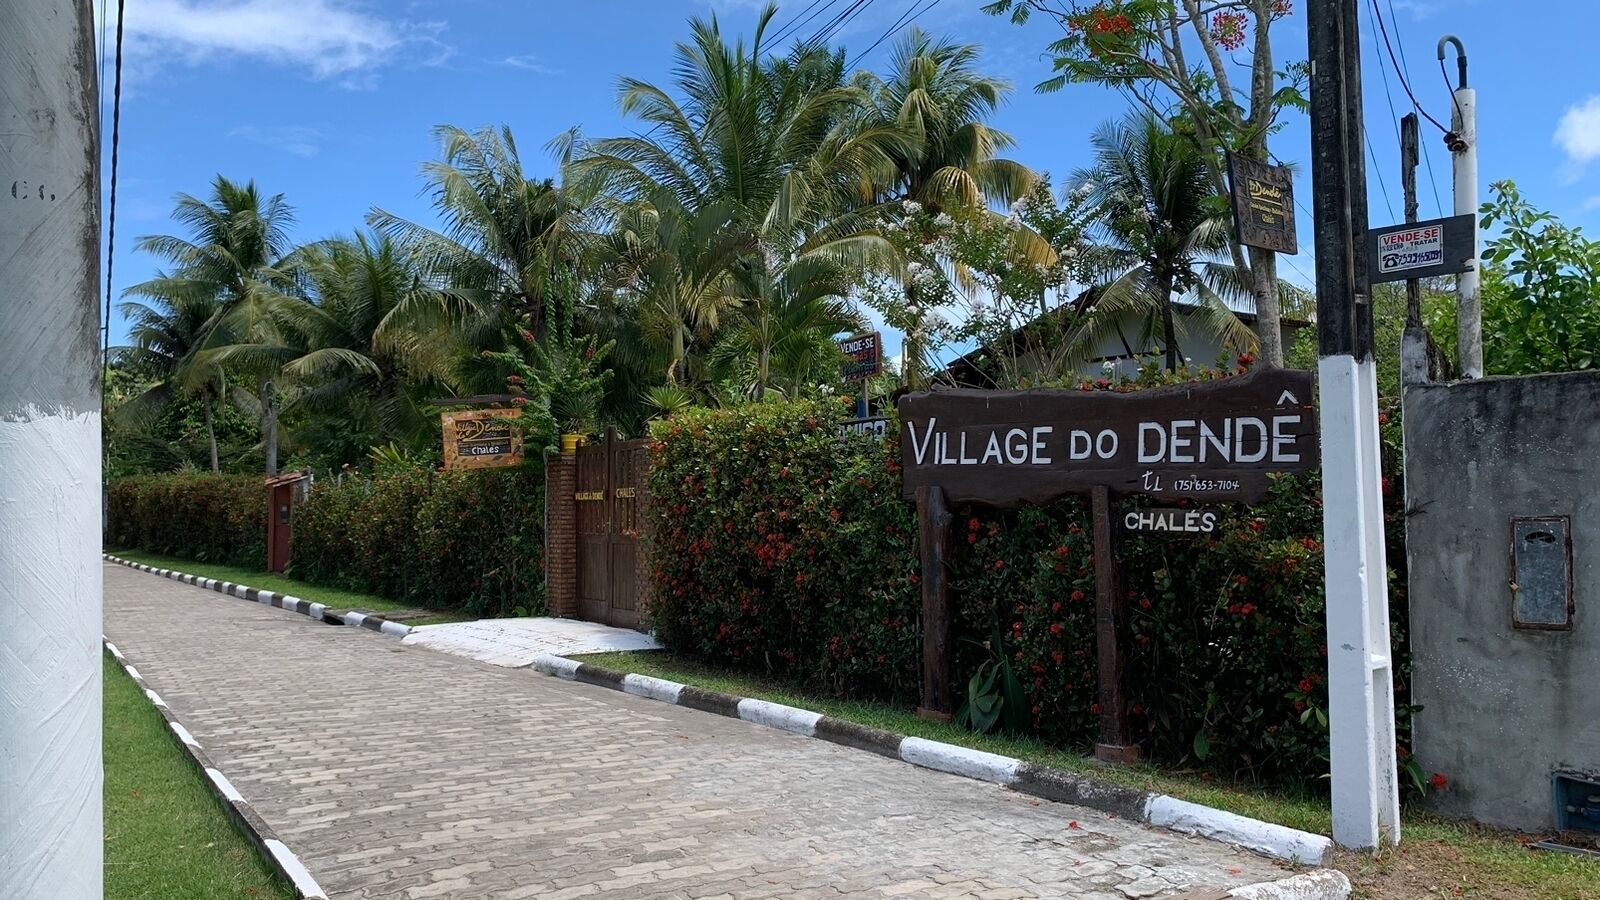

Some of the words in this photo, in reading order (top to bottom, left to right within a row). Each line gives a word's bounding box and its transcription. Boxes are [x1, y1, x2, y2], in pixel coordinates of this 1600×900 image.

[1384, 229, 1438, 245] VENDE-SE
[1410, 238, 1438, 246] TRATAR
[840, 337, 874, 353] VENDE-SE
[907, 417, 1053, 465] VILLAGE
[1070, 429, 1119, 460] DO
[1138, 389, 1301, 463] DENDÊ
[1124, 509, 1217, 532] CHALÉS
